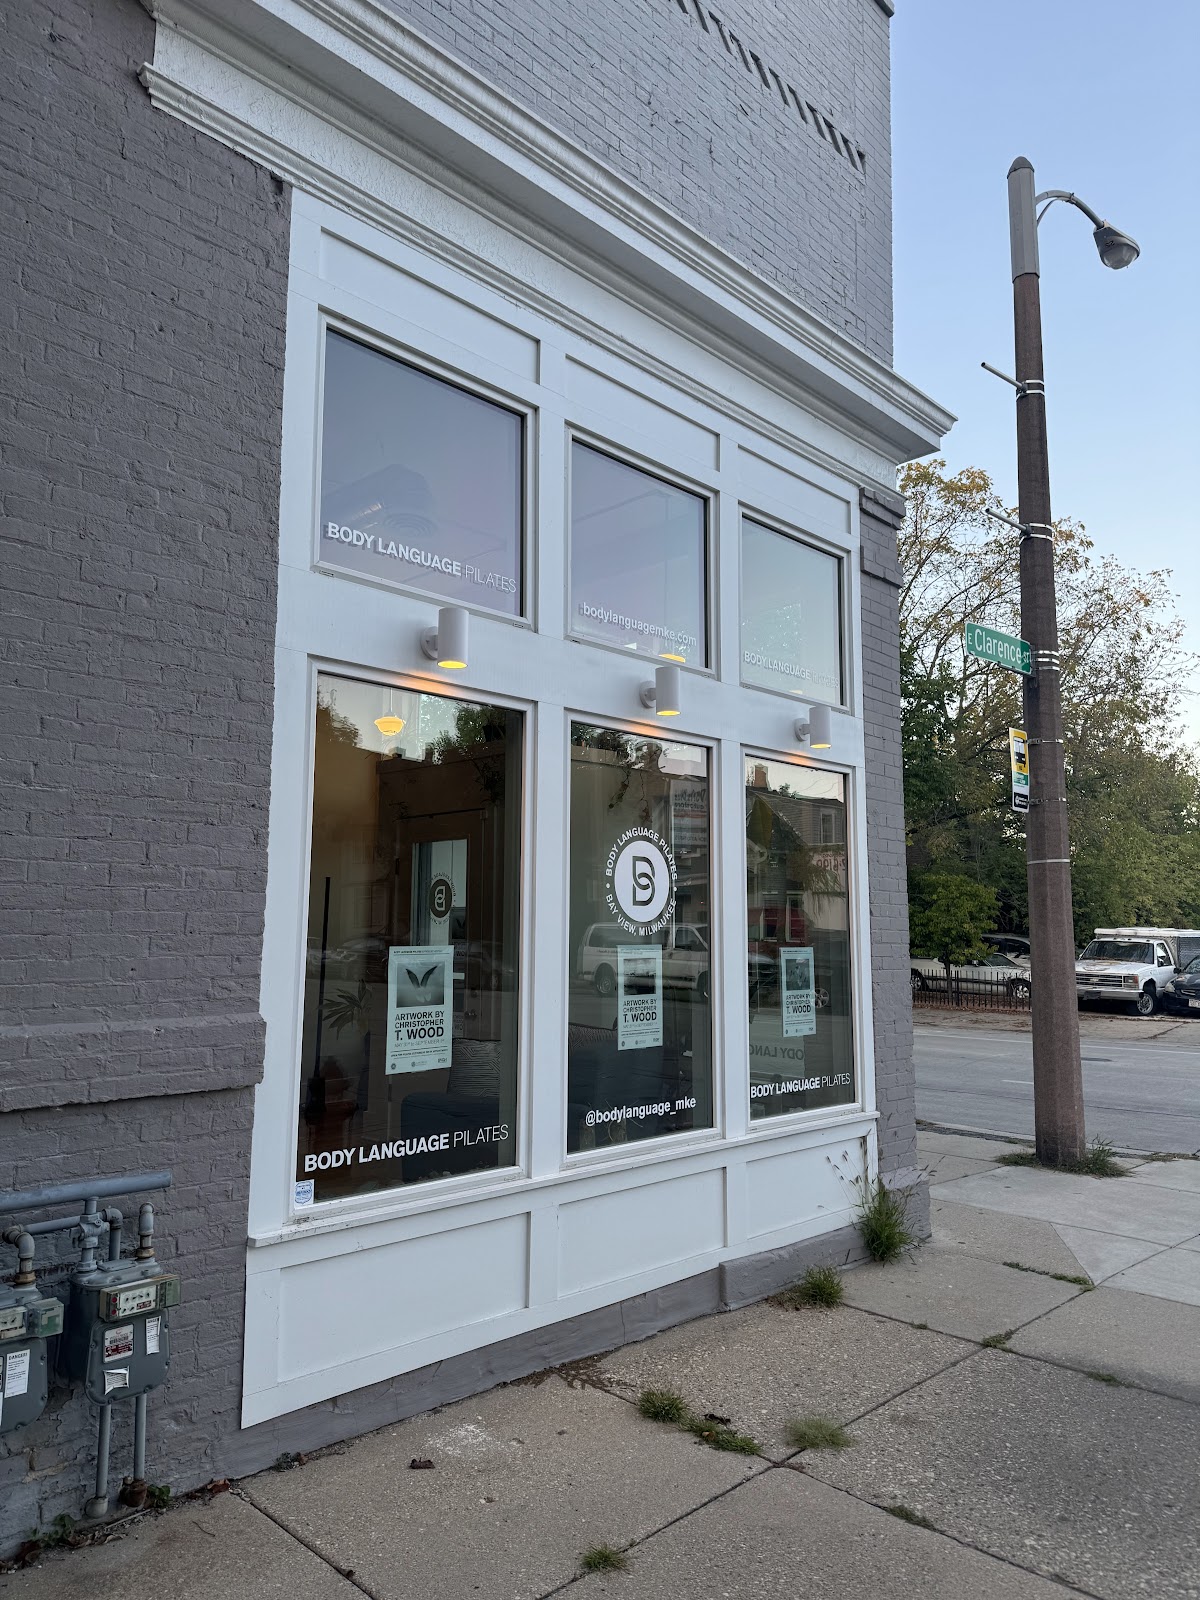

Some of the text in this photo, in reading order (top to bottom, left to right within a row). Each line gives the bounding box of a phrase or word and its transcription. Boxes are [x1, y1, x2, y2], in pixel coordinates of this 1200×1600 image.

[328, 522, 517, 593] BODY LANGUAGE PILATES
[583, 602, 697, 646] bodylanguagemke.com
[968, 633, 973, 645] E
[974, 628, 1022, 664] Clarence
[744, 651, 767, 666] BODY
[768, 658, 811, 680] LANGUAGE
[605, 827, 678, 880] BODY LANGUAGE PILATES
[605, 894, 677, 937] BAY VIEW, MILWAUKEE
[395, 1010, 445, 1021] ARTWORK BY
[623, 999, 649, 1007] ARTWORK
[623, 1005, 657, 1013] CHRISTOPHER
[786, 1005, 812, 1015] T. WOOD
[395, 1018, 444, 1029] CHRISTOPHER
[623, 1011, 657, 1023] T. WOOD
[394, 1029, 403, 1041] T.
[407, 1026, 445, 1040] WOOD
[750, 1073, 851, 1099] BODY LANGUAGE PILATES
[585, 1096, 697, 1127] @bodylanguage_mke
[304, 1124, 509, 1173] BODY LANGUAGE PILATES
